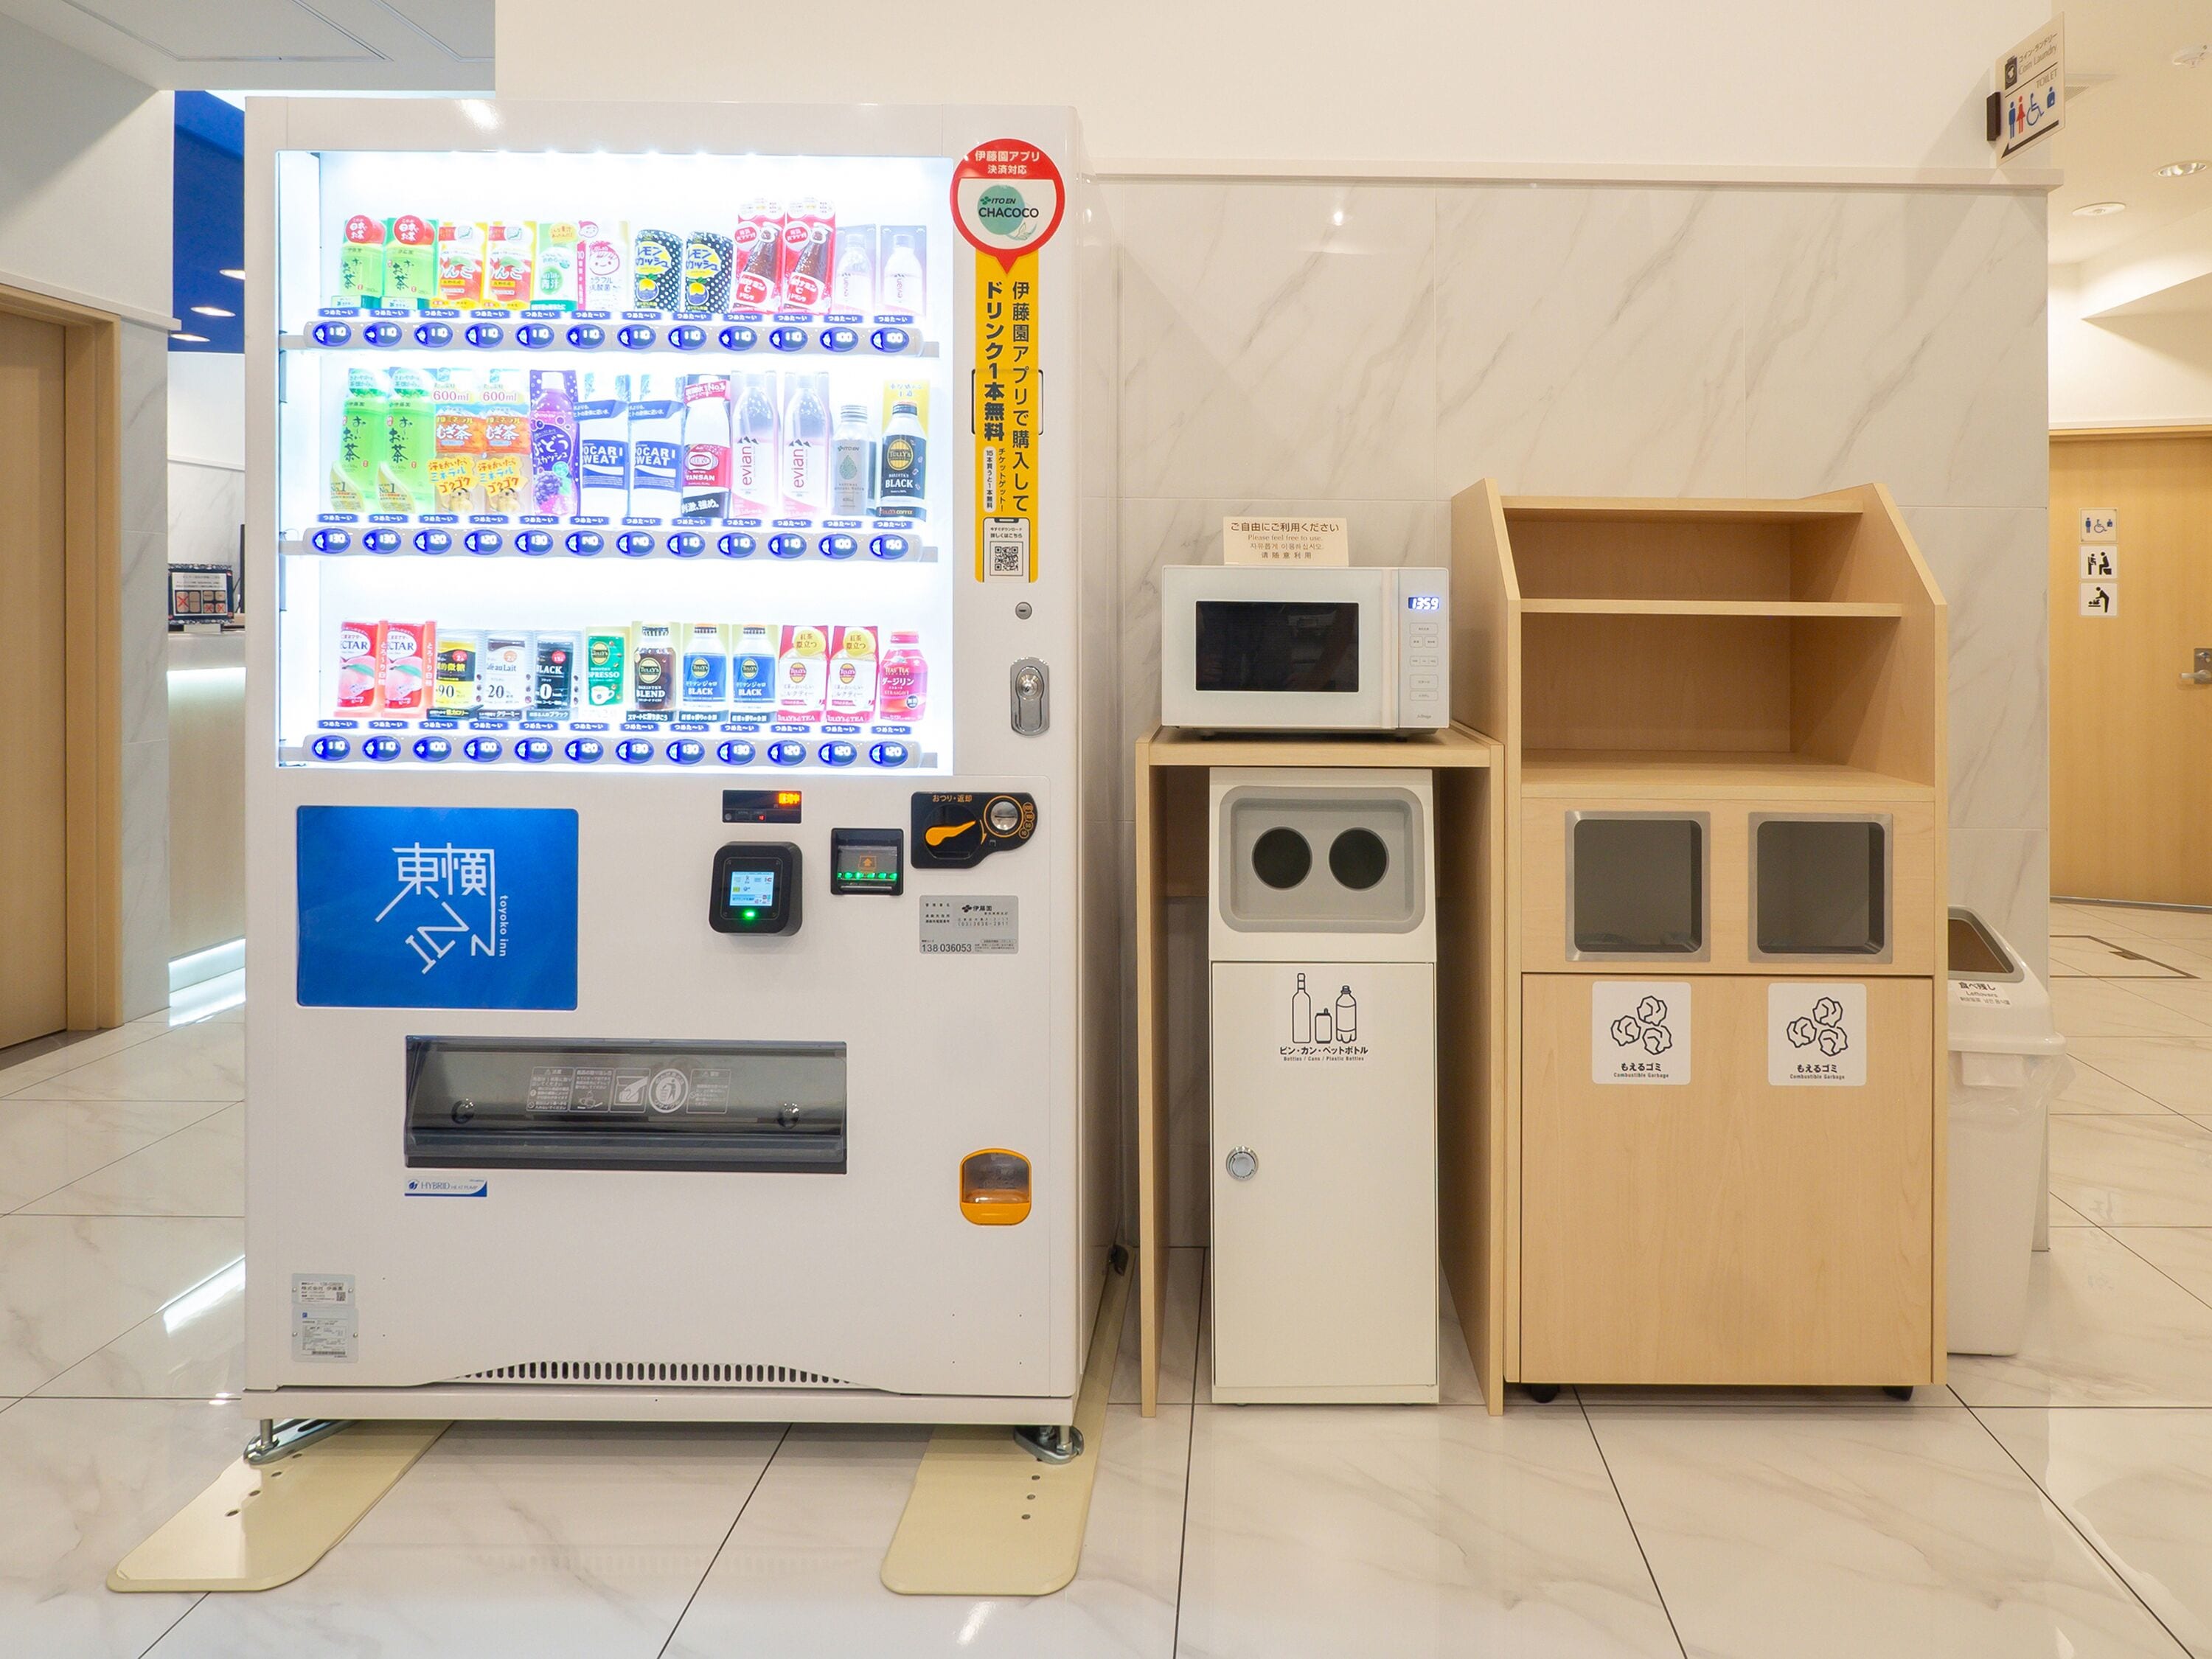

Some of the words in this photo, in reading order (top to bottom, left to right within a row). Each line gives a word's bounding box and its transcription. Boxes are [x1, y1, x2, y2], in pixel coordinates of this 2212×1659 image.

[2034, 44, 2057, 66] Laundry
[2036, 68, 2058, 89] TOILET
[975, 150, 1040, 162] 伊藤園アプリ
[987, 164, 1027, 175] 決済対応
[978, 207, 1040, 218] CHACOCO
[984, 281, 1005, 442] ドリンク1本無料
[433, 391, 469, 401] 600ml
[483, 391, 517, 401] 600ml
[1012, 282, 1030, 512] 伊藤園アプリで購入して
[740, 445, 753, 486] evian
[791, 448, 804, 488] evian
[885, 479, 914, 488] BLACK
[1231, 522, 1340, 532] ご自由にご利用ください
[487, 685, 504, 698] 20
[637, 689, 666, 698] BLEND
[498, 894, 509, 935] toyoko
[499, 939, 509, 956] inn
[922, 944, 938, 952] 138
[940, 944, 972, 952] 036053
[1621, 1062, 1662, 1071] もえるゴミ
[1797, 1064, 1837, 1073] もえるゴミ
